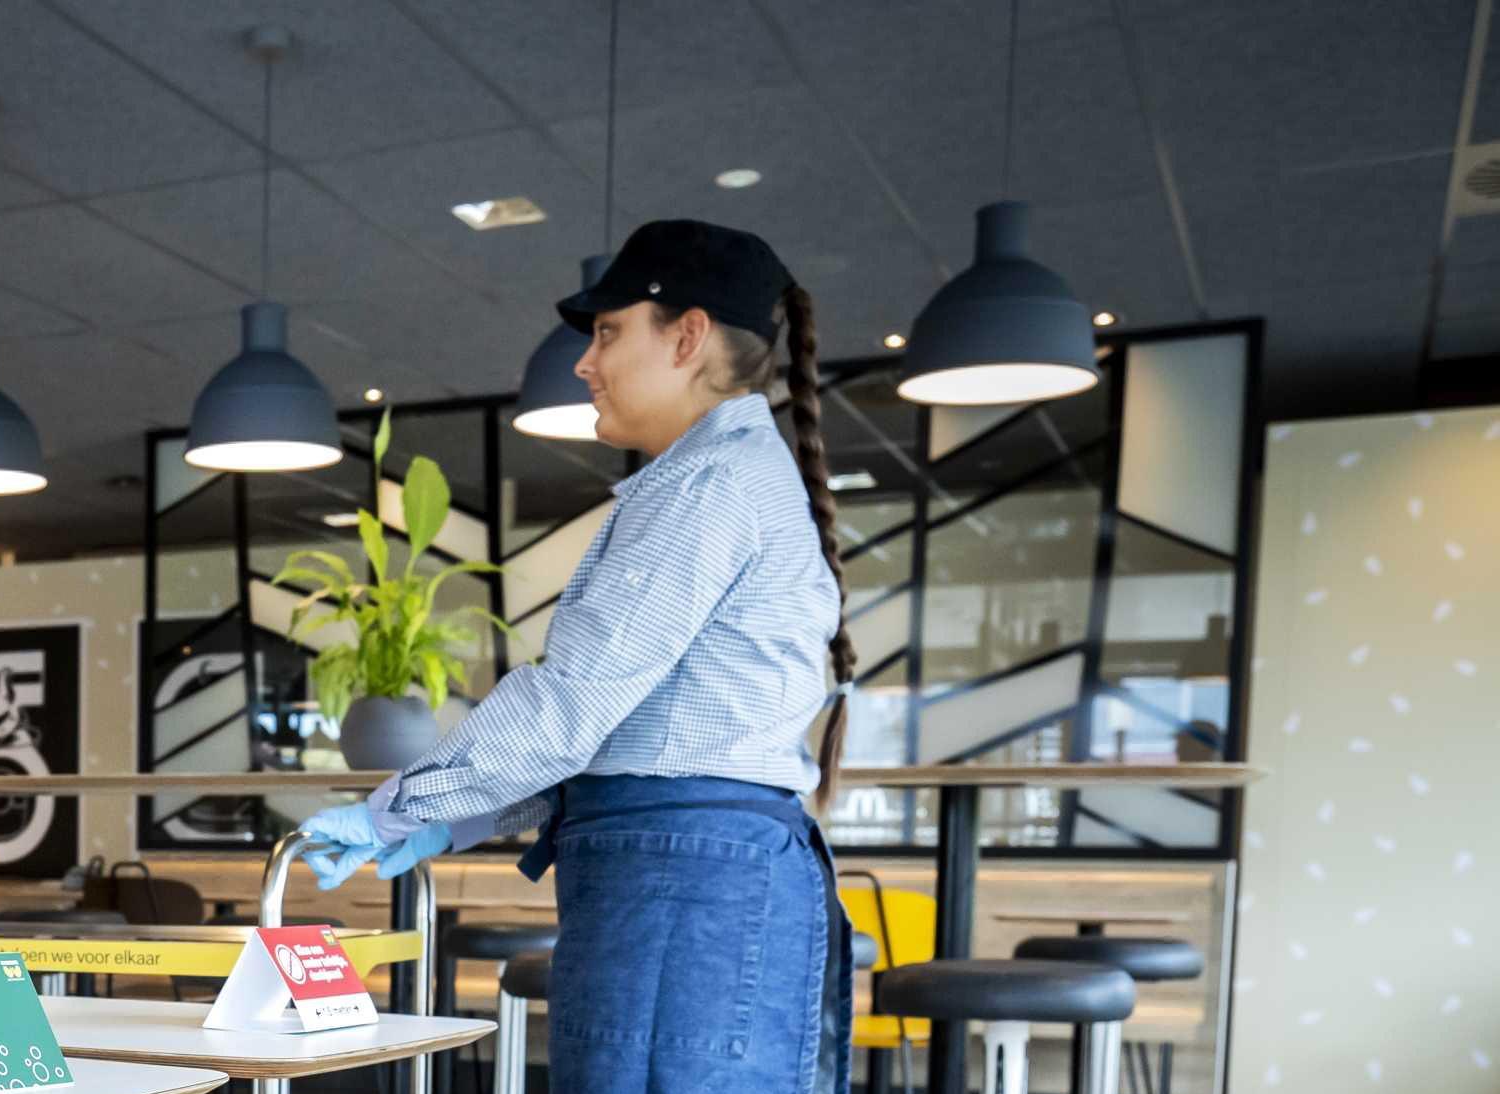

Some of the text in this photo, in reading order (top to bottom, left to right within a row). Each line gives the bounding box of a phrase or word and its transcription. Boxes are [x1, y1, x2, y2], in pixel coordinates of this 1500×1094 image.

[51, 951, 74, 963] we
[76, 951, 112, 965] voor
[114, 949, 162, 966] elkaar
